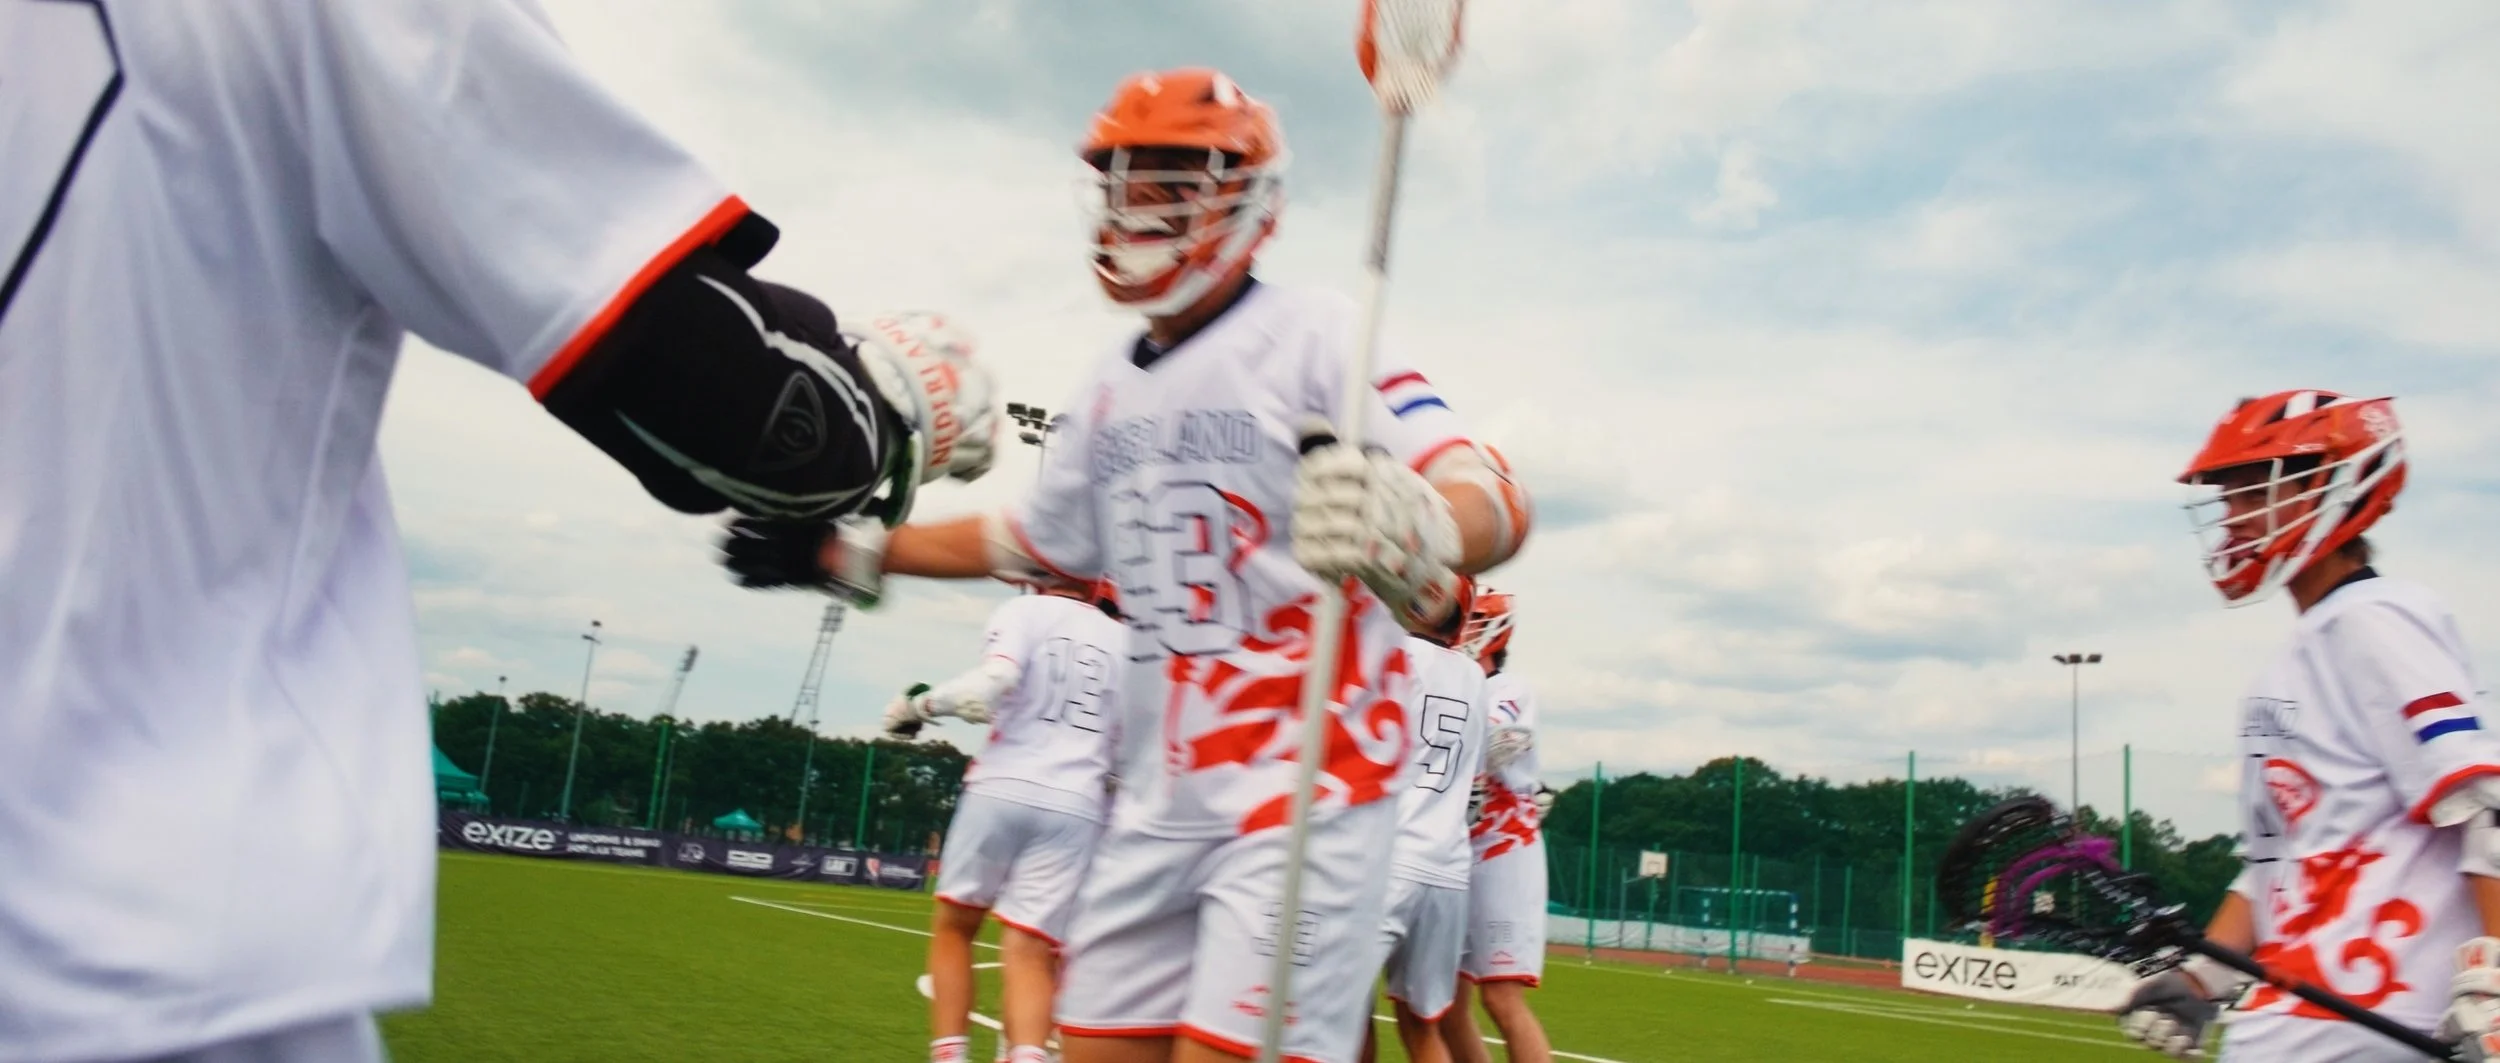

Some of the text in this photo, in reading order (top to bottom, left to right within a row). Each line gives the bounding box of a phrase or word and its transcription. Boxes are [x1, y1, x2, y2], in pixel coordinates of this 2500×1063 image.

[1036, 636, 1113, 733] 13
[1413, 693, 1469, 793] 5
[462, 821, 557, 850] exize
[1915, 951, 2018, 990] exize
